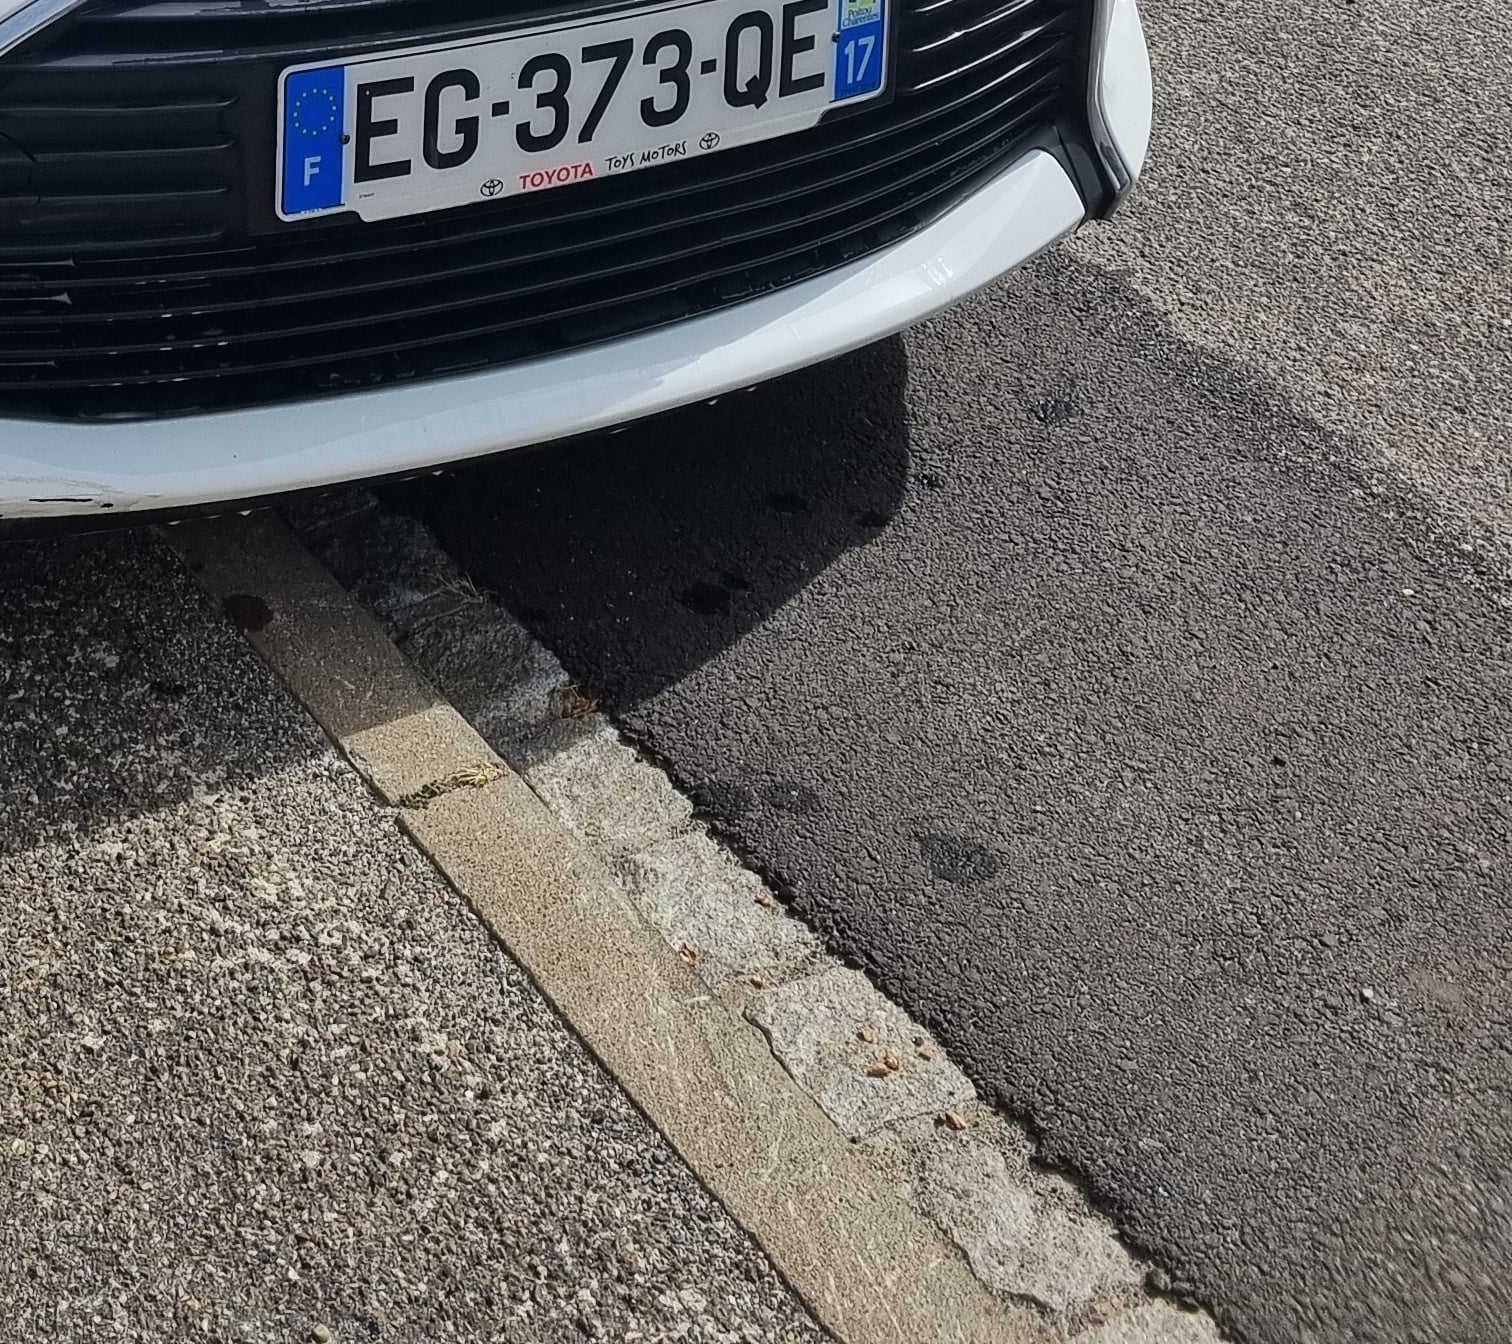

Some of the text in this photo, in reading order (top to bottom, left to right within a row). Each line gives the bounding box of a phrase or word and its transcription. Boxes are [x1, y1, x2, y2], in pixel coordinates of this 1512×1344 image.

[844, 34, 876, 85] 17
[303, 155, 322, 187] F
[519, 162, 594, 190] TOYOTA
